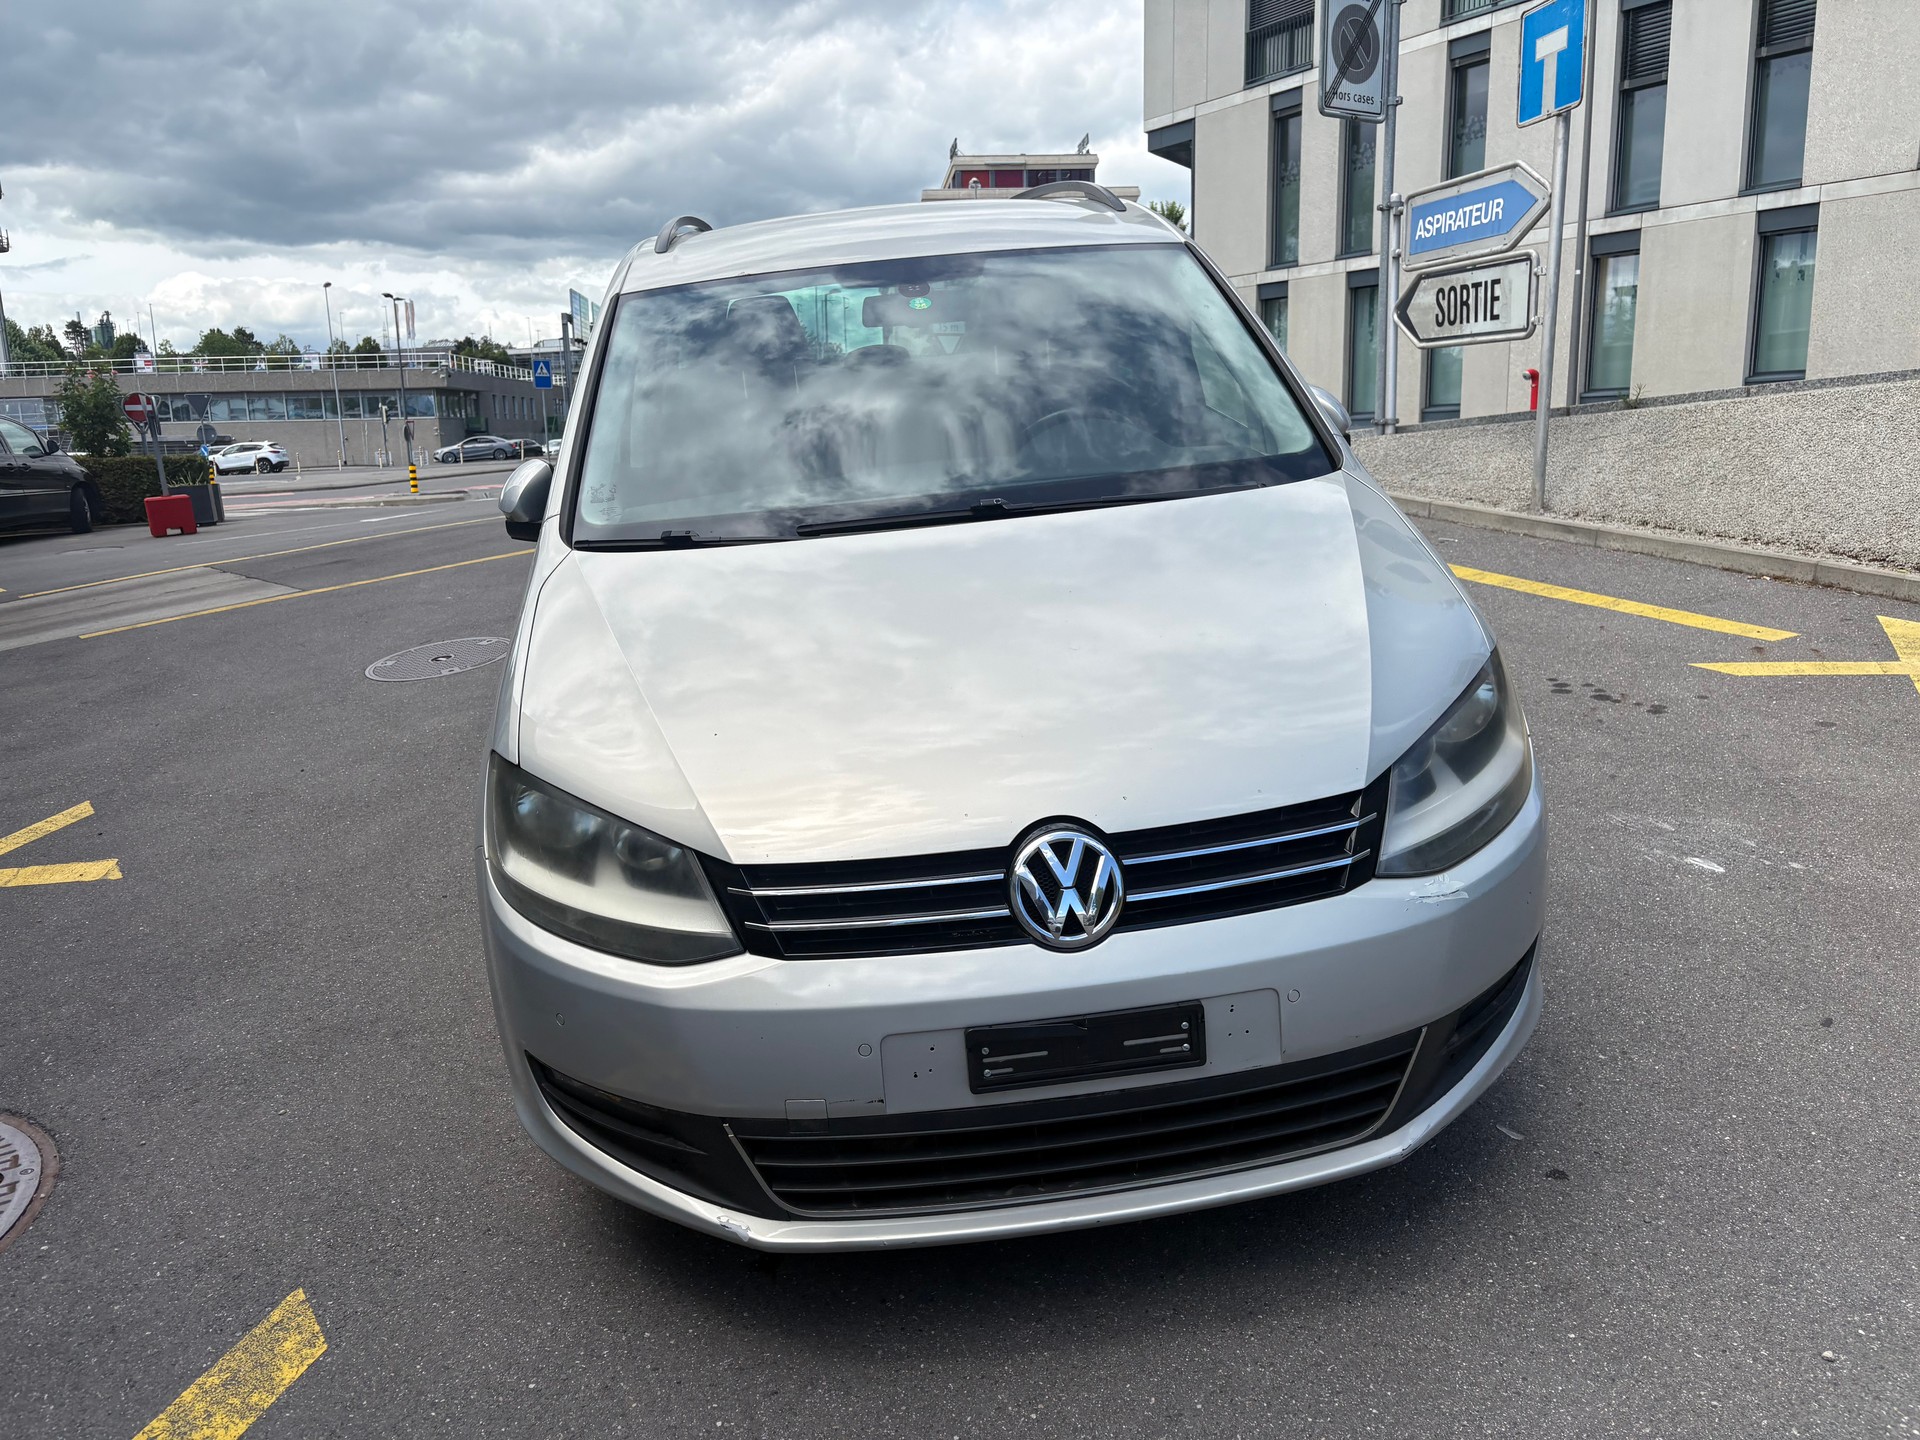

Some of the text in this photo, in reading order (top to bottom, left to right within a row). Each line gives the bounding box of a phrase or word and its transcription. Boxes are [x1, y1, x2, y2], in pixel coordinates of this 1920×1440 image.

[1353, 93, 1375, 105] cases
[1415, 198, 1504, 241] ASPIRATEUR
[1435, 278, 1501, 328] SORTIE
[1016, 837, 1114, 939] VW
